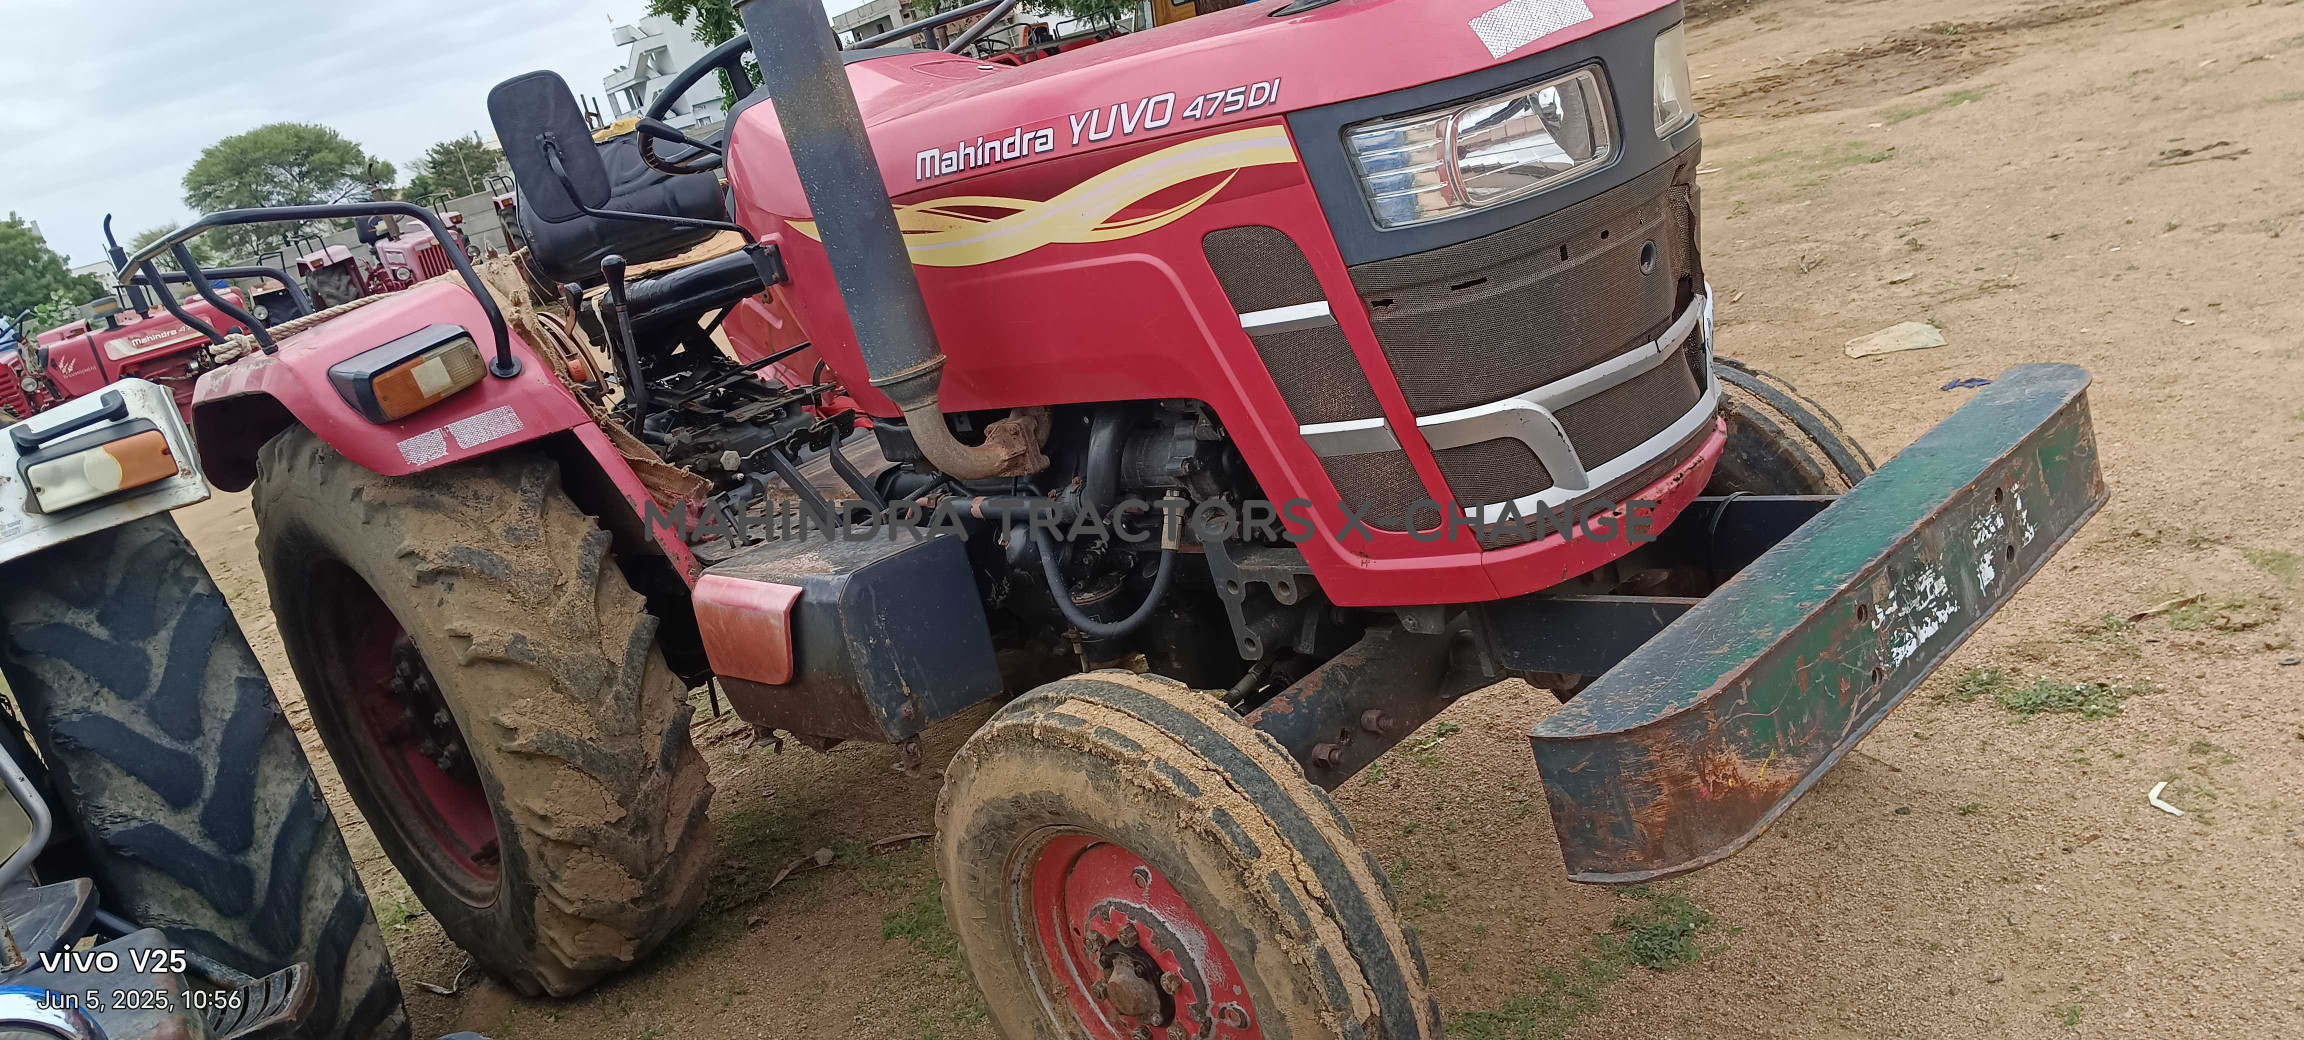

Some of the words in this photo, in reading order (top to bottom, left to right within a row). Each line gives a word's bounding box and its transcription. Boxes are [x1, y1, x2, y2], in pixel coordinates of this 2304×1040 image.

[915, 126, 1056, 182] Mahindra
[1068, 92, 1176, 147] YUVO
[1182, 78, 1282, 121] 475DI
[131, 329, 178, 347] Mahindra
